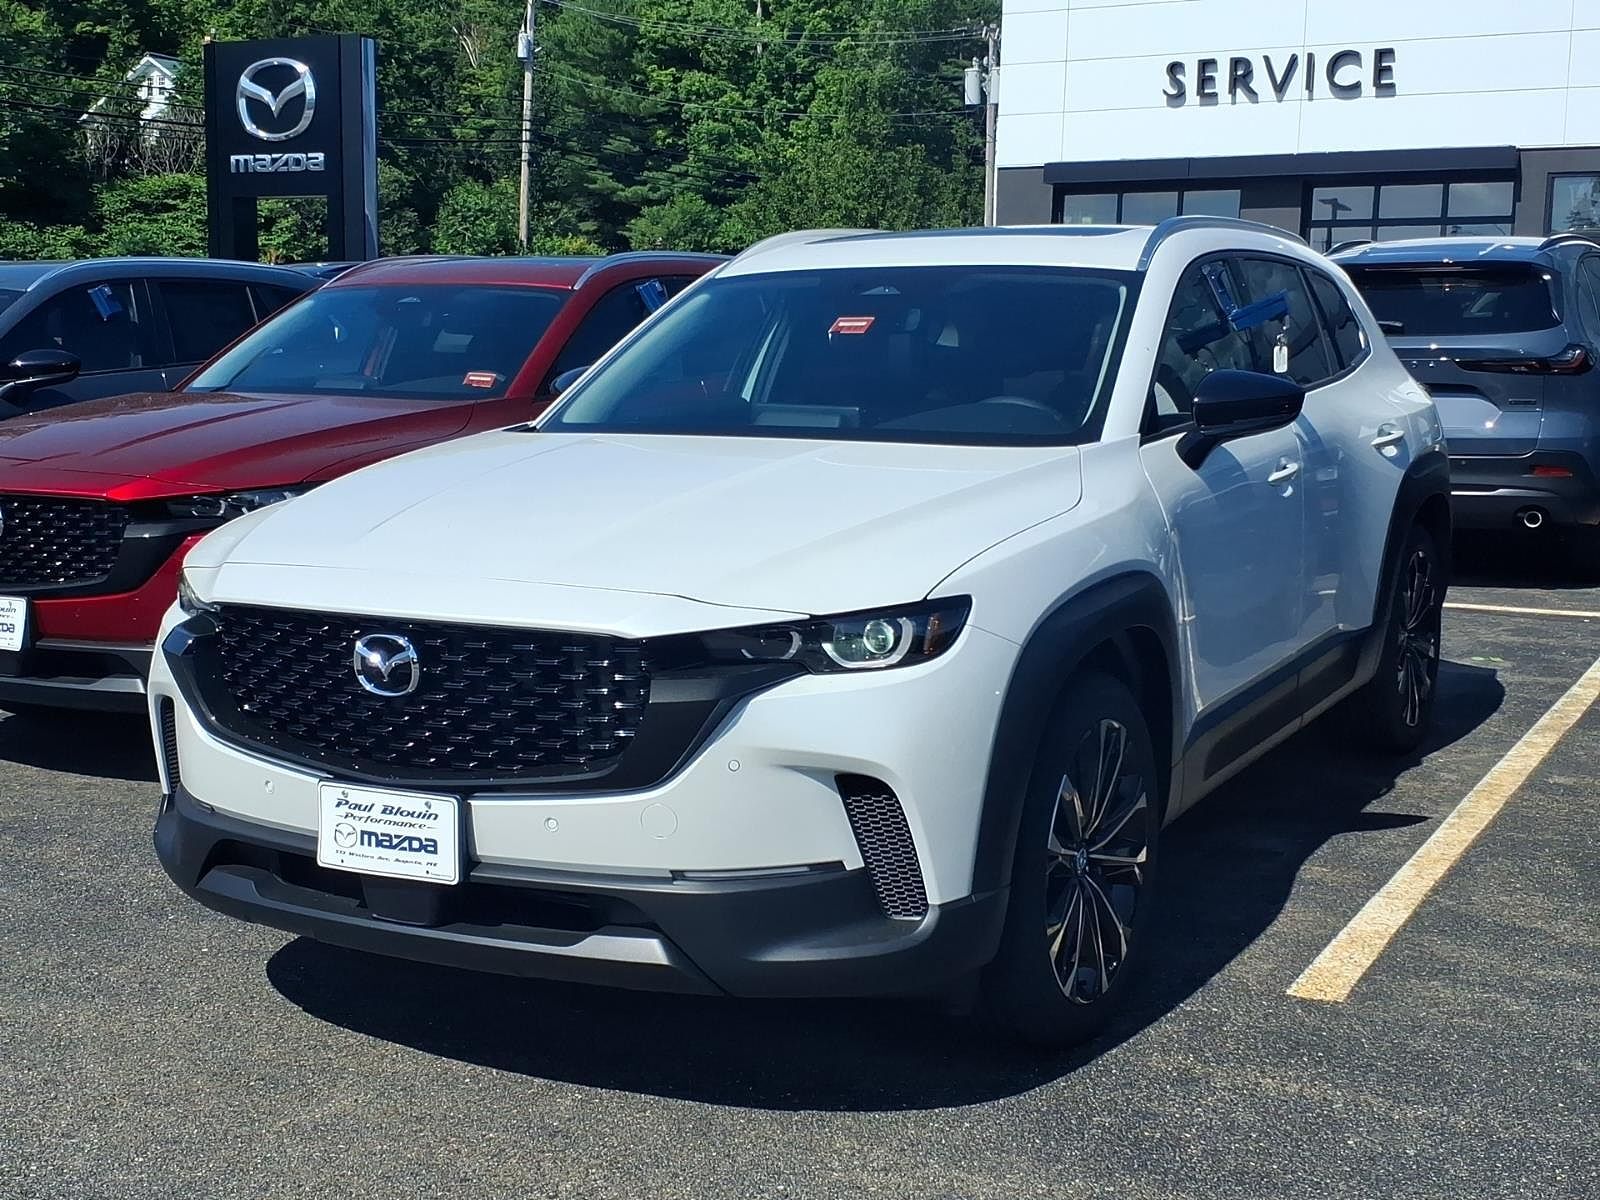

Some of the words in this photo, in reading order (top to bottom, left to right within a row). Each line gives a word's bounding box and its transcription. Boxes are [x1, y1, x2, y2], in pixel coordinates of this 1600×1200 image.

[1162, 48, 1397, 108] SERVICE
[335, 798, 375, 813] Paul
[380, 804, 439, 821] Blouin
[344, 812, 426, 829] Performance
